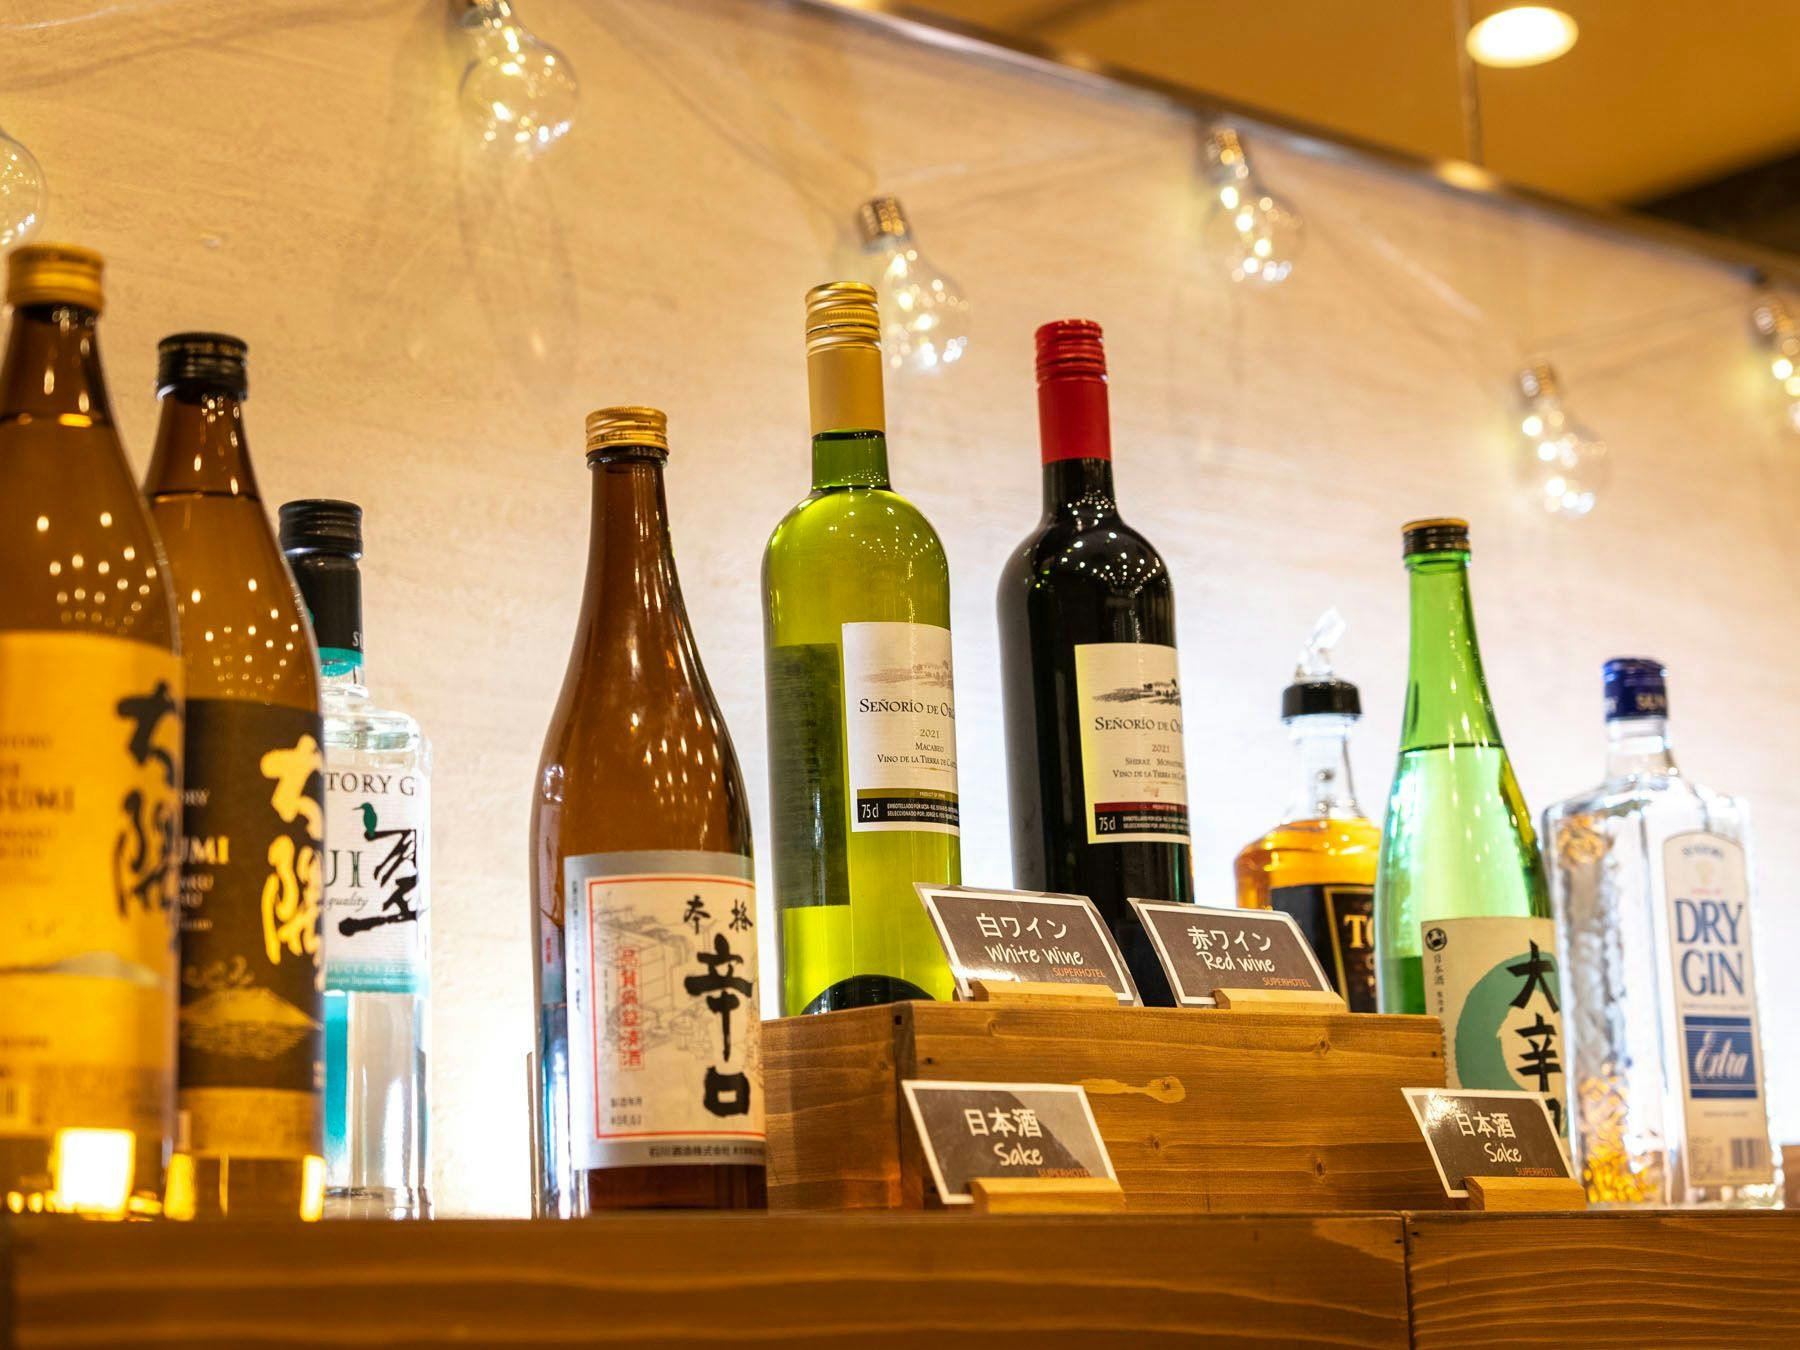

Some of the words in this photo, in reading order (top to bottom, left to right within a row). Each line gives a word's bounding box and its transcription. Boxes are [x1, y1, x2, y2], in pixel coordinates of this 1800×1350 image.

[859, 697, 924, 713] SEÑORÍO
[926, 704, 939, 715] DE
[919, 728, 941, 738] 2021
[1095, 716, 1155, 731] SEÑORÍO
[1157, 721, 1169, 731] DE
[1151, 744, 1171, 753] 2021
[877, 754, 899, 763] VINO
[900, 755, 910, 763] DE
[920, 755, 940, 766] TIERRA
[1112, 769, 1133, 778] VINO
[861, 804, 871, 818] 75
[872, 803, 879, 818] cl
[1099, 817, 1108, 831] 75
[1109, 816, 1116, 831] cl
[975, 912, 1068, 940] 白ワイン
[1674, 898, 1743, 946] DRY
[1187, 925, 1272, 952] 赤ワイン
[984, 943, 1040, 964] White
[1196, 951, 1236, 971] Red
[1053, 967, 1106, 979] SUPERHOTEL
[1680, 949, 1745, 996] GIN
[1262, 977, 1312, 988] SUPERHOTEL
[684, 932, 755, 1118] 辛口
[964, 1106, 1043, 1138] 日本酒
[1455, 1111, 1517, 1139] 日本酒
[993, 1142, 1044, 1167] Sake
[1483, 1142, 1522, 1163] Sake
[1514, 1167, 1559, 1177] SUPERHOTEL
